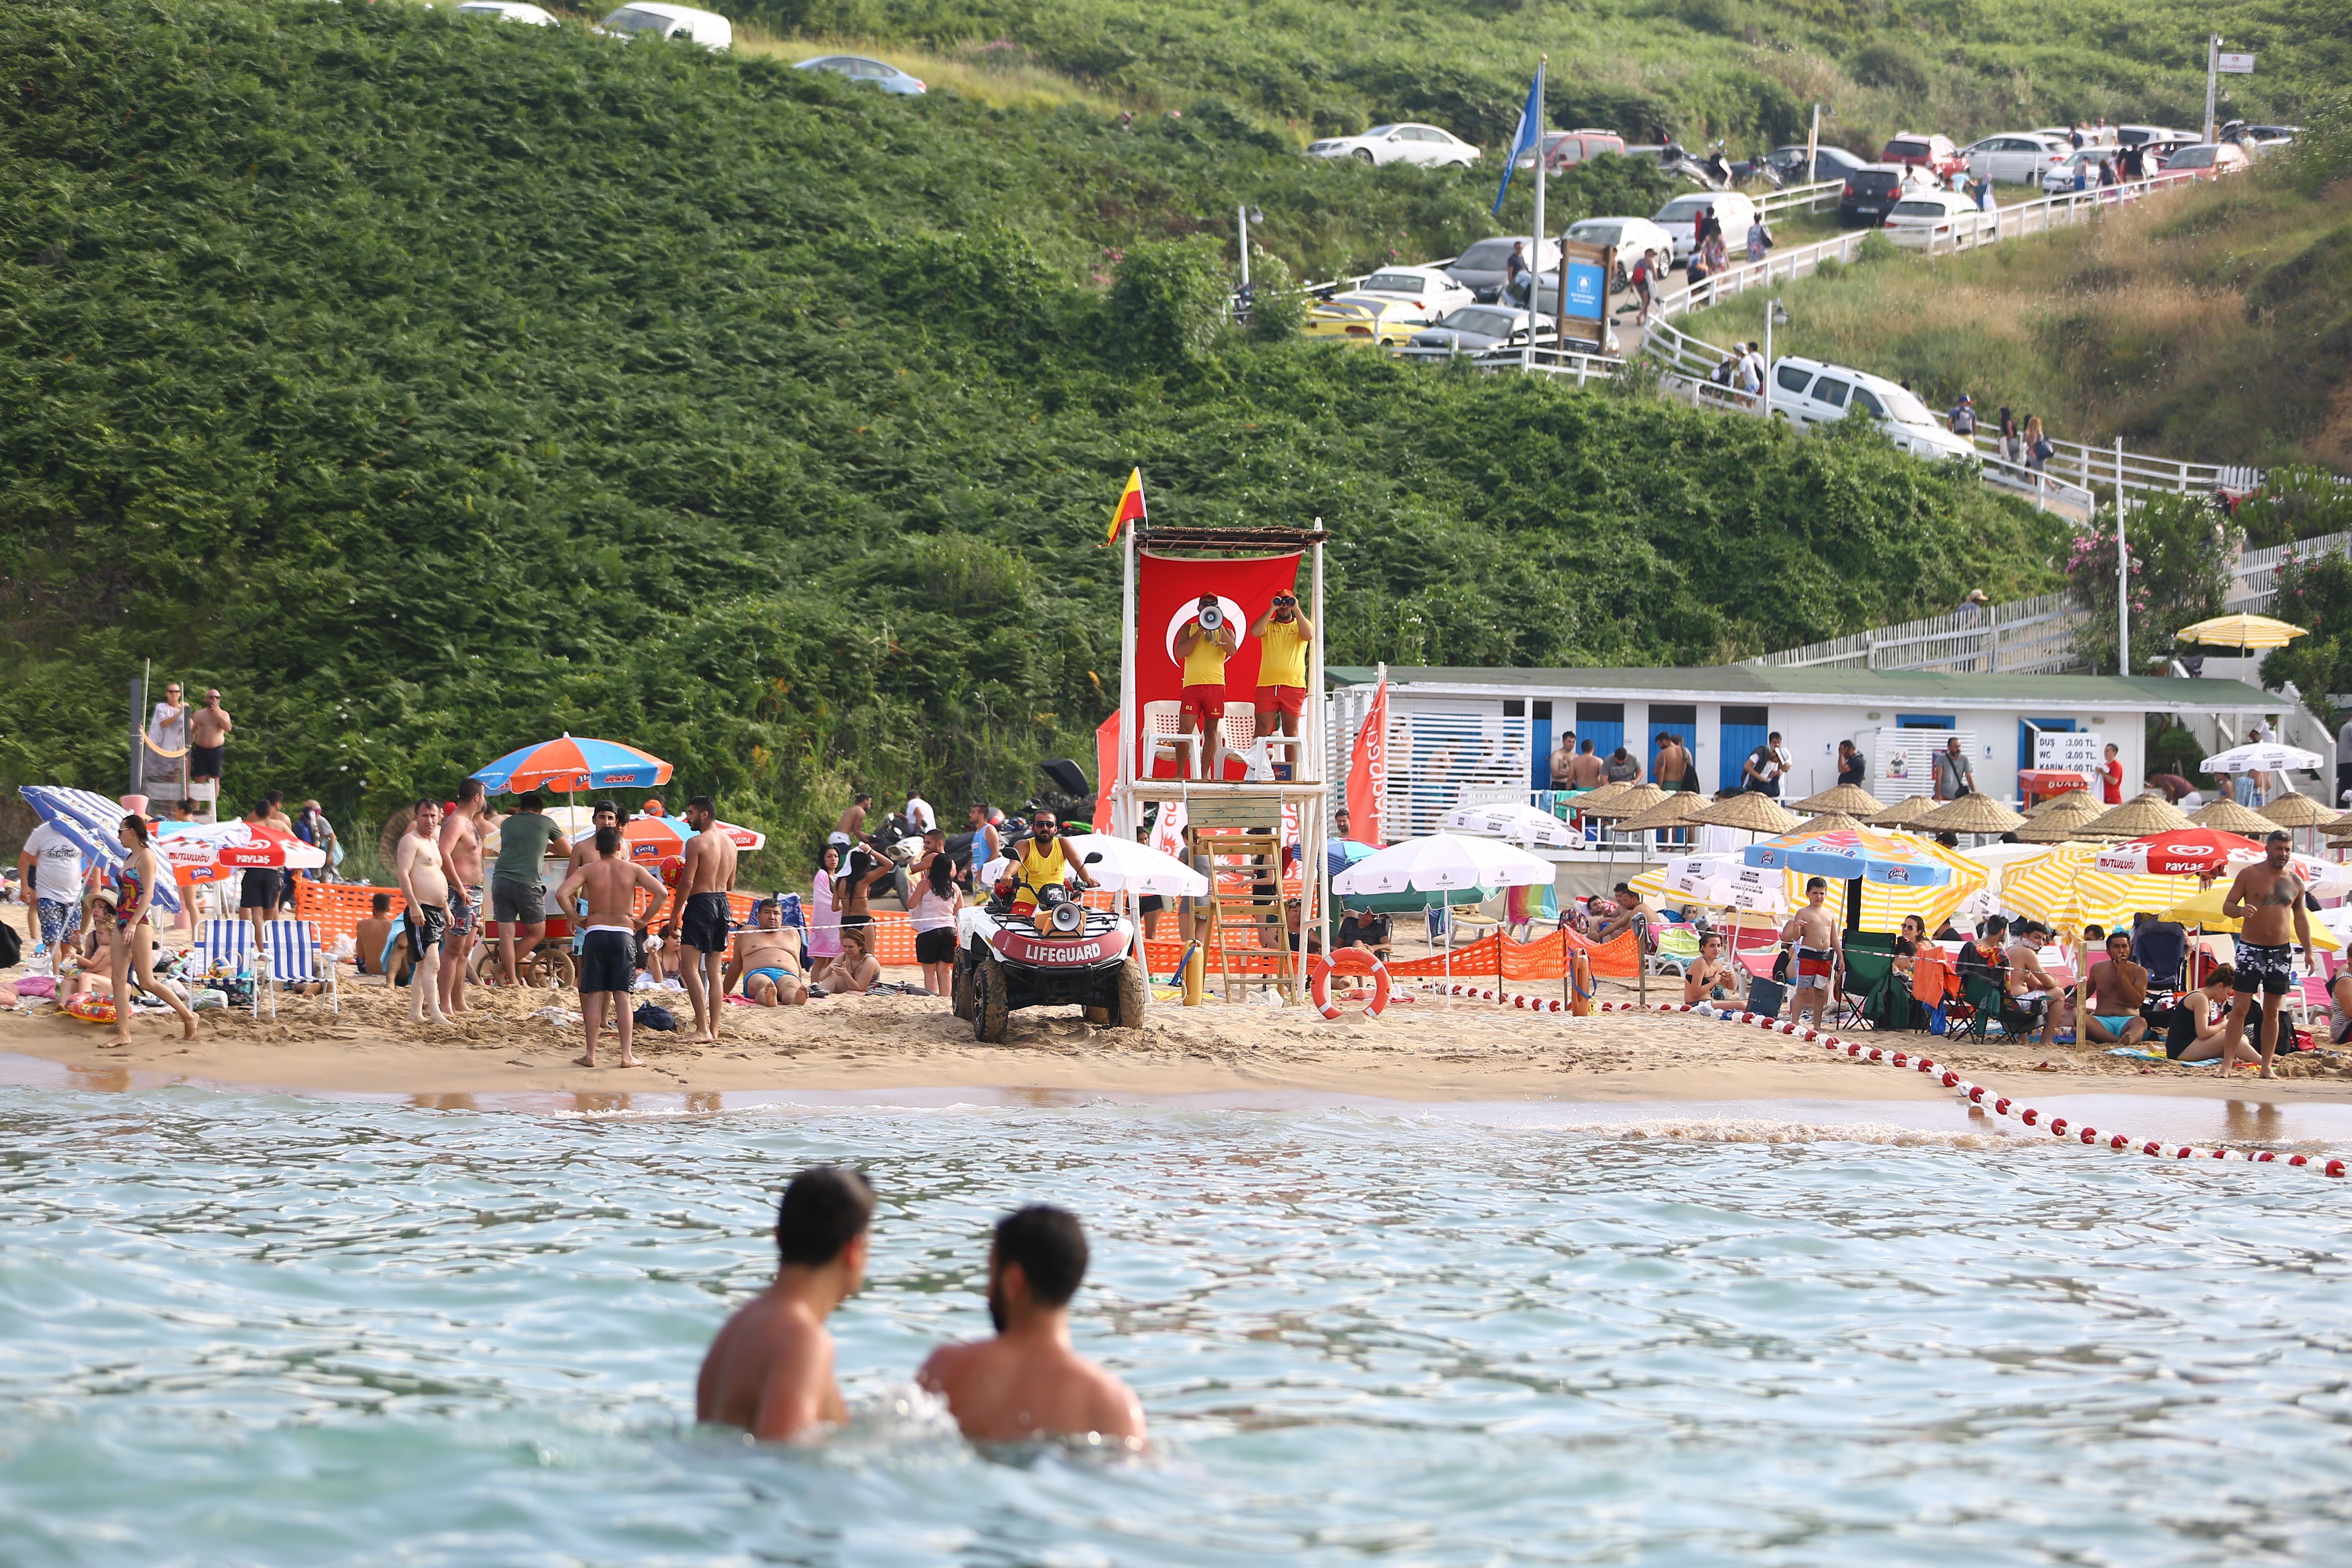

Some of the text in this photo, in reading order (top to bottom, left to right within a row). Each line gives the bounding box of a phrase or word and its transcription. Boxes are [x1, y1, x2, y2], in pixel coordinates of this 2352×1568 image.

[2040, 739, 2055, 748] DUŞ
[2040, 762, 2062, 770] KABİN
[605, 775, 635, 783] ÜLKER
[169, 852, 210, 863] MUTLULUĞU
[2100, 858, 2136, 870] MUTLULUĞU
[1025, 942, 1101, 963] LIFEGUARD
